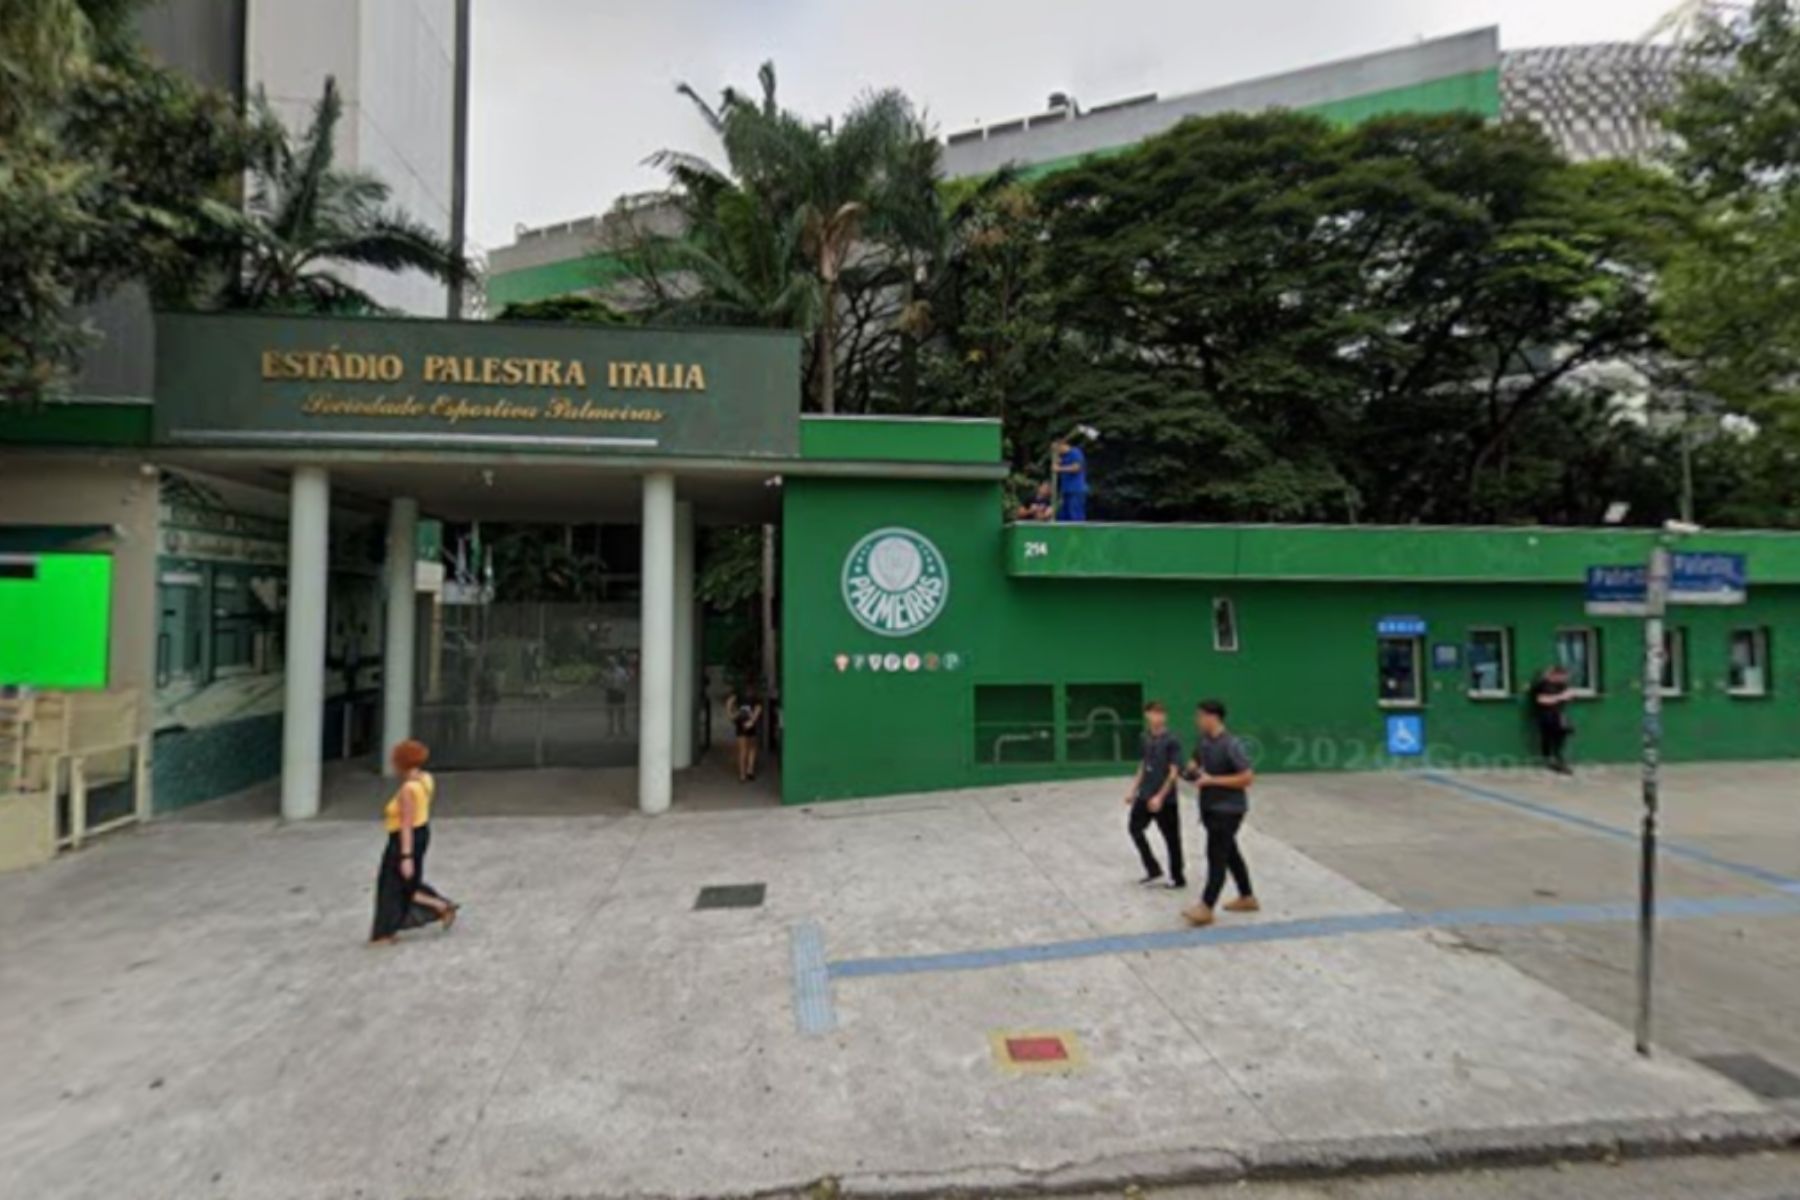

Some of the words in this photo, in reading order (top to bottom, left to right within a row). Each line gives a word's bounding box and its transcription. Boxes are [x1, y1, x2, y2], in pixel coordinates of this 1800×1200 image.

[261, 343, 404, 382] ESTÁDIO
[423, 354, 588, 387] PALESTRA
[607, 360, 707, 391] ITALIA
[543, 397, 667, 424] Palmeiras
[849, 574, 943, 630] PALMEIRAS
